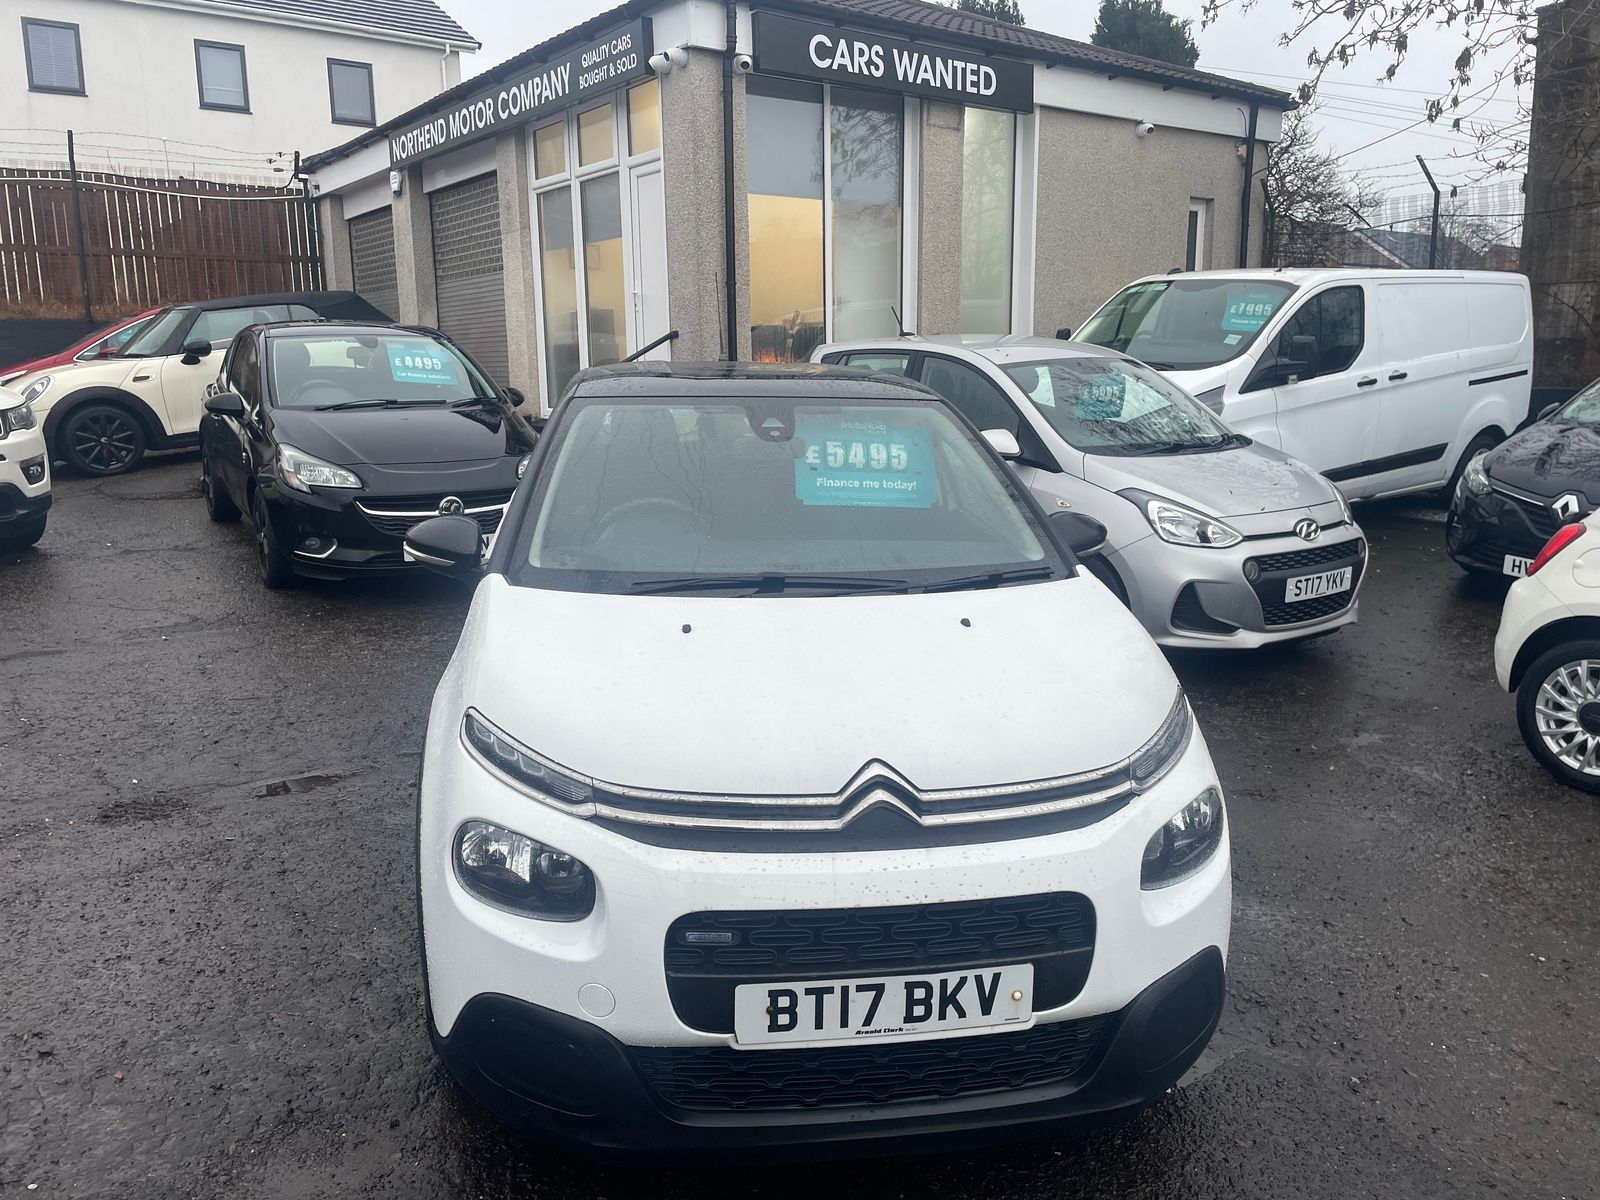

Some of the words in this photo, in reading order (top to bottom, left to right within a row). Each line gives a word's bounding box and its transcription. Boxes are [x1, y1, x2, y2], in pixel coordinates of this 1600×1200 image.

[581, 43, 610, 68] QUALITY
[611, 33, 632, 55] CARS
[809, 34, 885, 78] CARS
[893, 48, 997, 96] WANTED
[579, 65, 608, 90] BOUGHT
[609, 64, 616, 77] &
[616, 53, 638, 74] SOLD
[392, 118, 447, 162] NORTHEND
[449, 97, 495, 140] MOTOR
[498, 62, 572, 120] COMPANY
[1230, 302, 1273, 316] £7995
[395, 355, 442, 370] £4495
[805, 441, 908, 470] £5495
[816, 477, 860, 488] Finance
[863, 480, 880, 488] me
[883, 479, 917, 491] today!
[1294, 575, 1323, 597] ST17
[1326, 570, 1346, 591] YKV
[767, 982, 886, 1033] BT17
[903, 971, 1002, 1025] BKV
[855, 1028, 882, 1036] Arnold
[883, 1026, 904, 1034] Clark
